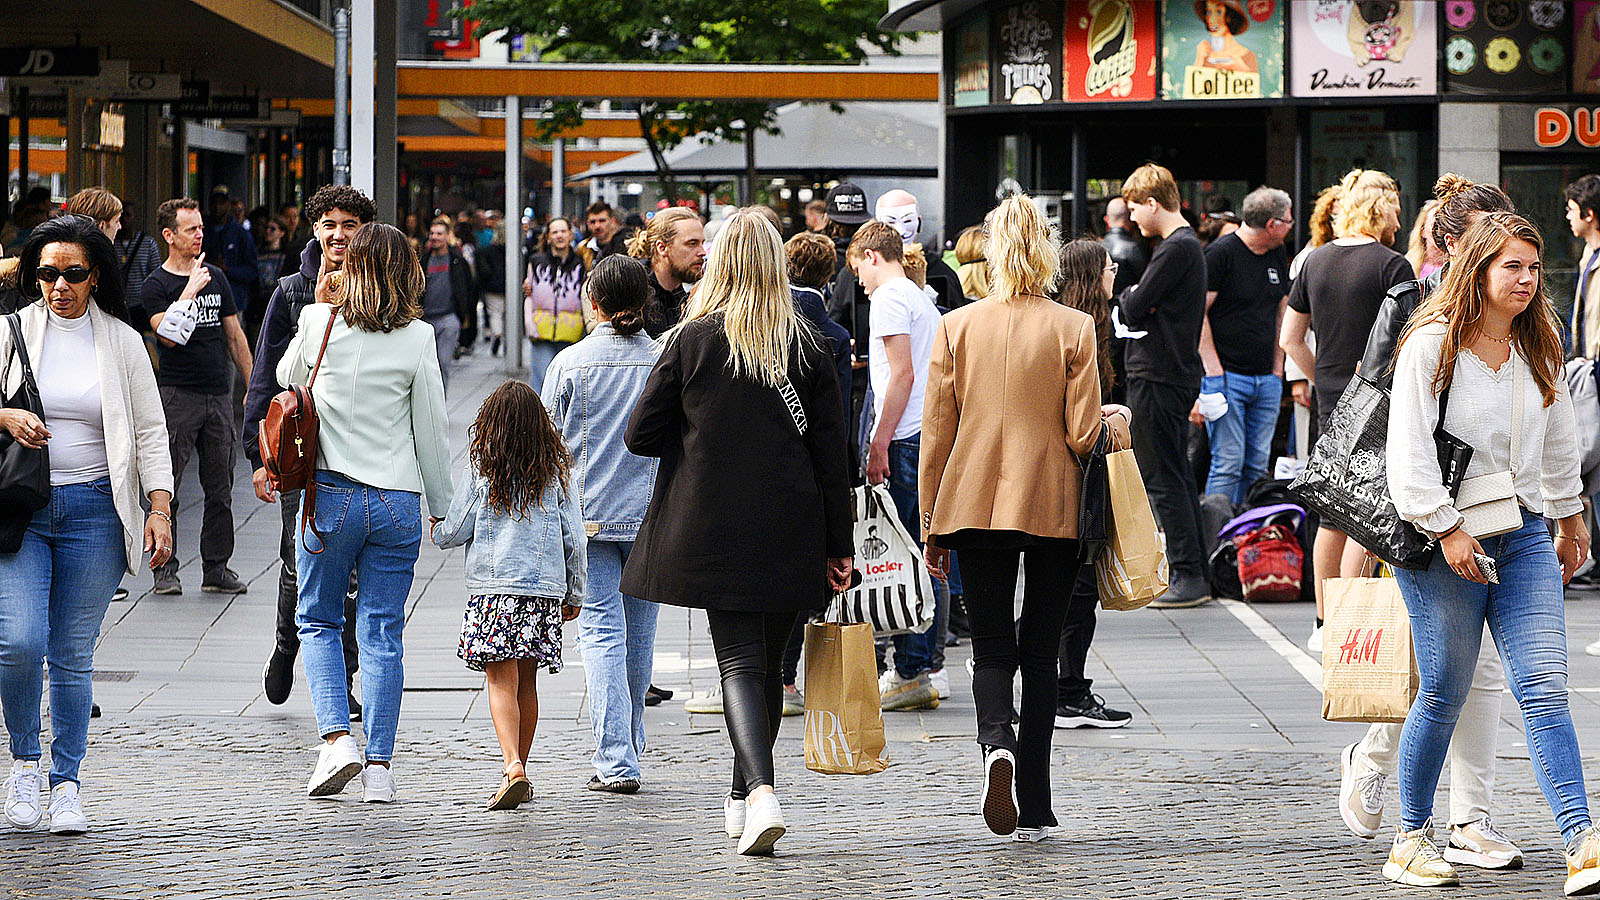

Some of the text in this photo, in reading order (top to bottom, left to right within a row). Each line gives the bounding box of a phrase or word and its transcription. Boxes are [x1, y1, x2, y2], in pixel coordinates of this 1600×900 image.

[20, 49, 54, 74] JD
[1192, 70, 1254, 96] Coffee
[779, 383, 808, 436] NIKKIE
[1338, 628, 1384, 665] H&M
